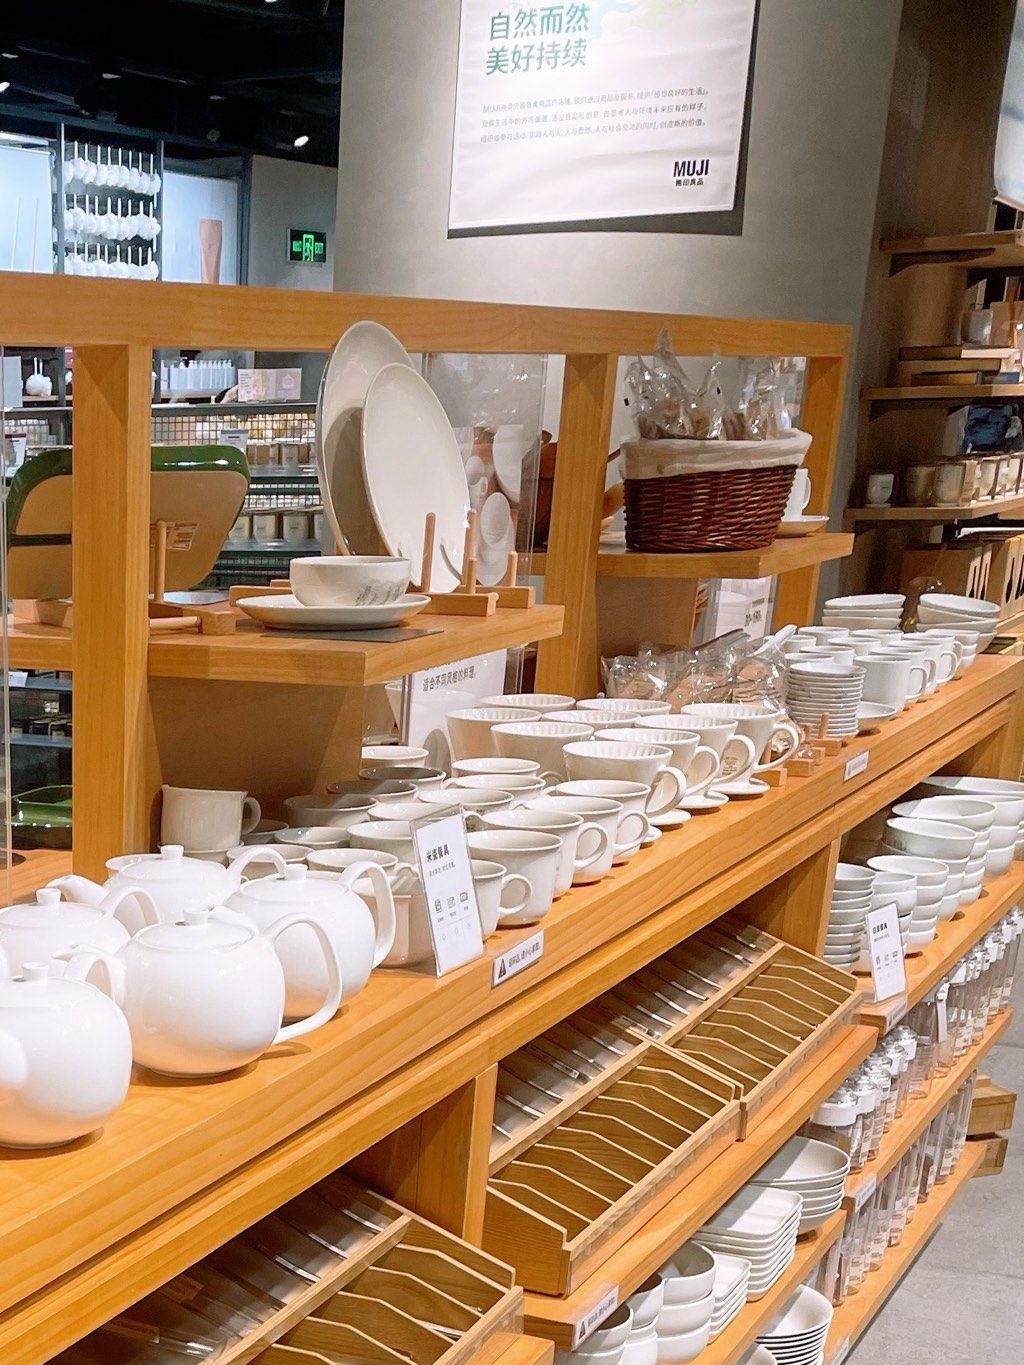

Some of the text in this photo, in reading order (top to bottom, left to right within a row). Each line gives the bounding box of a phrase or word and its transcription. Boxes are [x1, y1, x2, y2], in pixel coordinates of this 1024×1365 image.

[490, 3, 590, 41] 自然而然
[486, 37, 588, 76] 美好持续
[673, 159, 710, 177] MUJI
